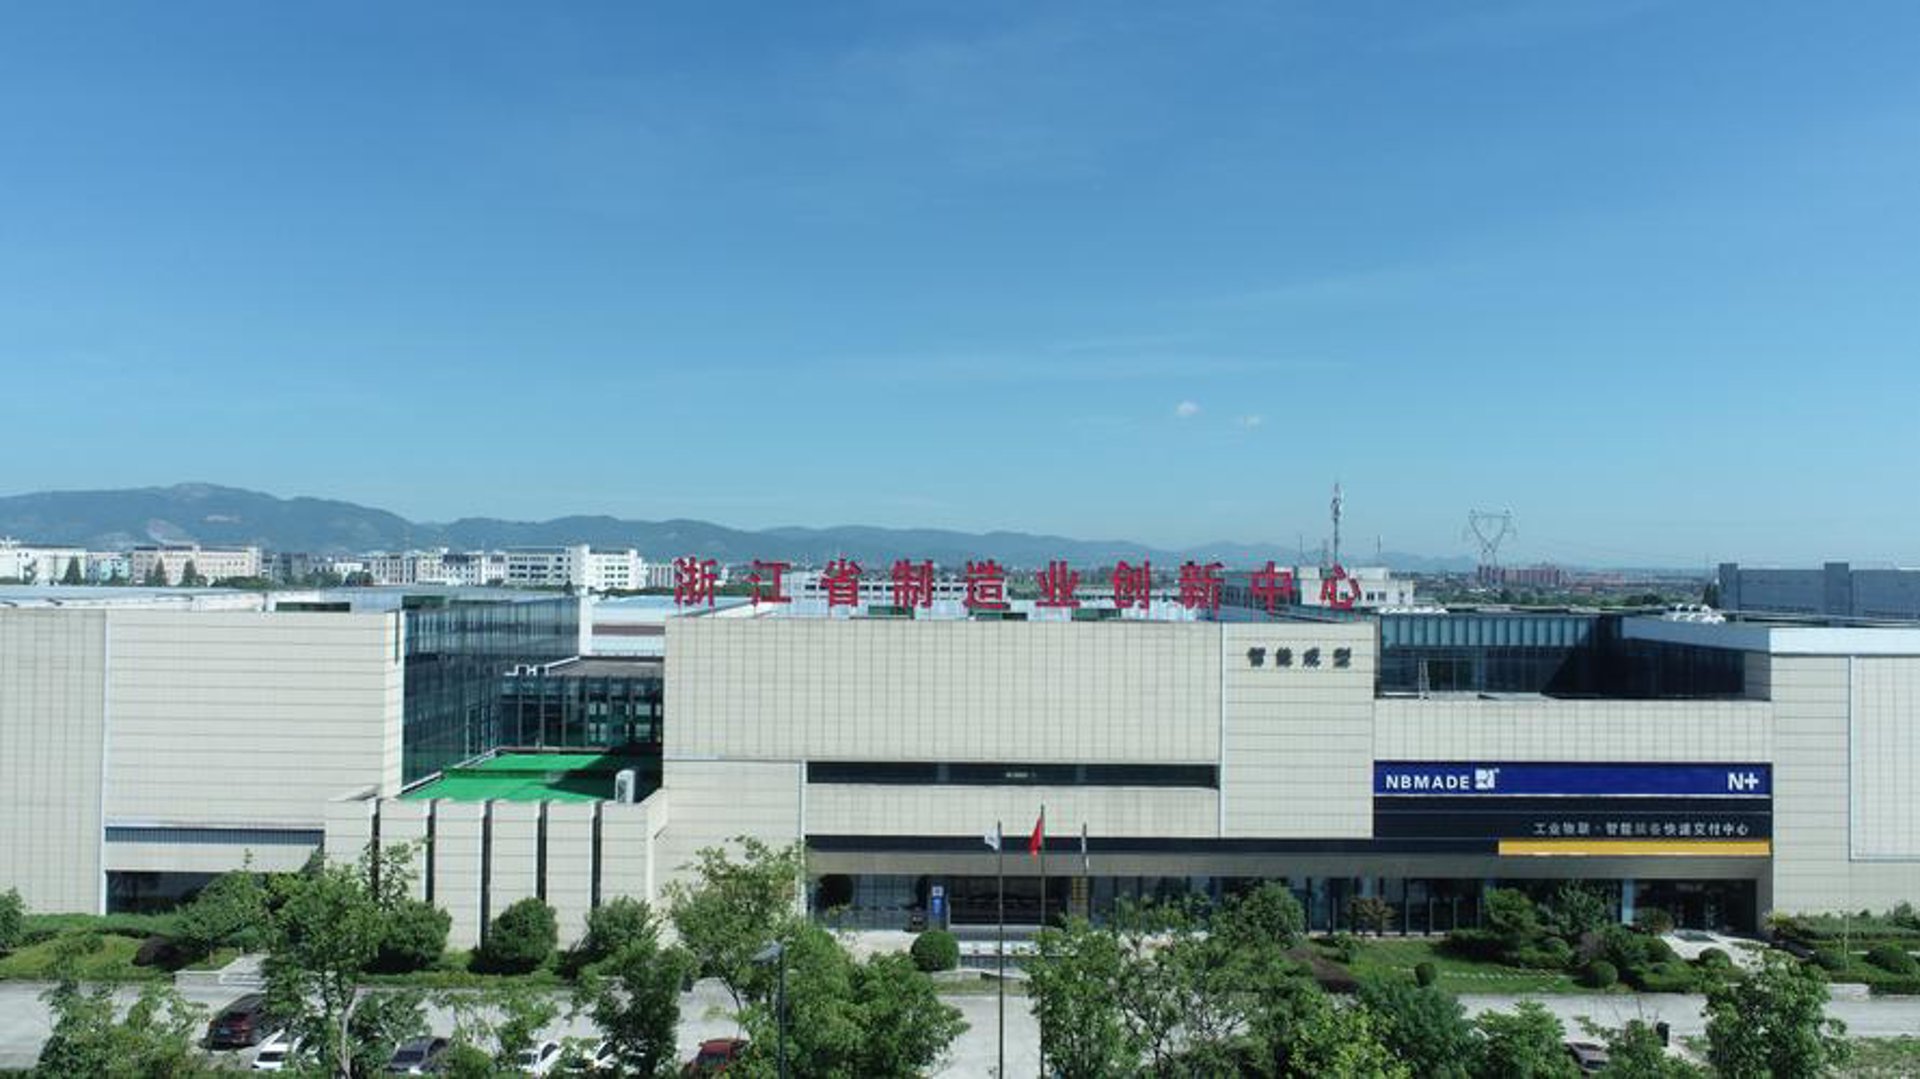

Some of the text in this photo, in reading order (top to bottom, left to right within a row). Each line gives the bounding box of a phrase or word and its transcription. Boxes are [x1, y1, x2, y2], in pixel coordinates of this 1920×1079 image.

[674, 558, 1362, 611] 浙江省制造业创新中心
[1385, 774, 1470, 790] NBMADE
[1727, 772, 1759, 790] N+
